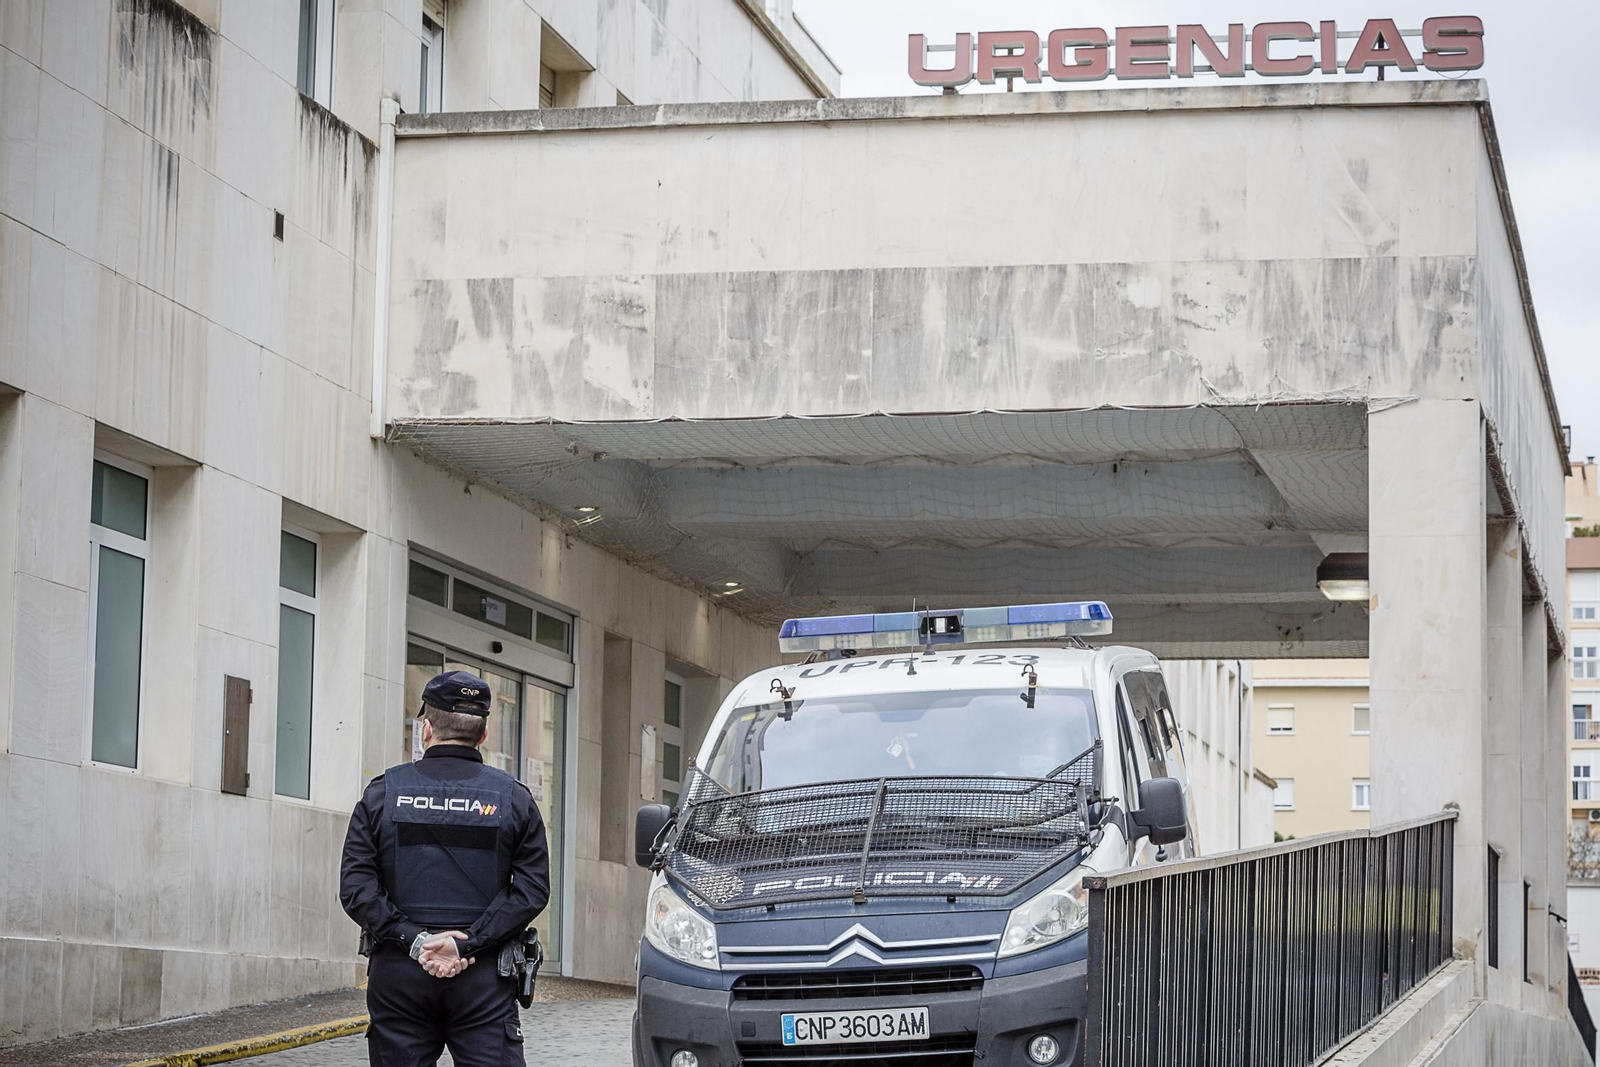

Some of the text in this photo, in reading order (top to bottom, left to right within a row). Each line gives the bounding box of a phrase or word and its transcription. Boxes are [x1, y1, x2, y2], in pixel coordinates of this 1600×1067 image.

[908, 15, 1485, 86] URGENCIAS
[799, 654, 1040, 678] UPR-123
[460, 687, 480, 696] CNP
[397, 796, 483, 812] POLICIA
[753, 871, 968, 896] POLICIA
